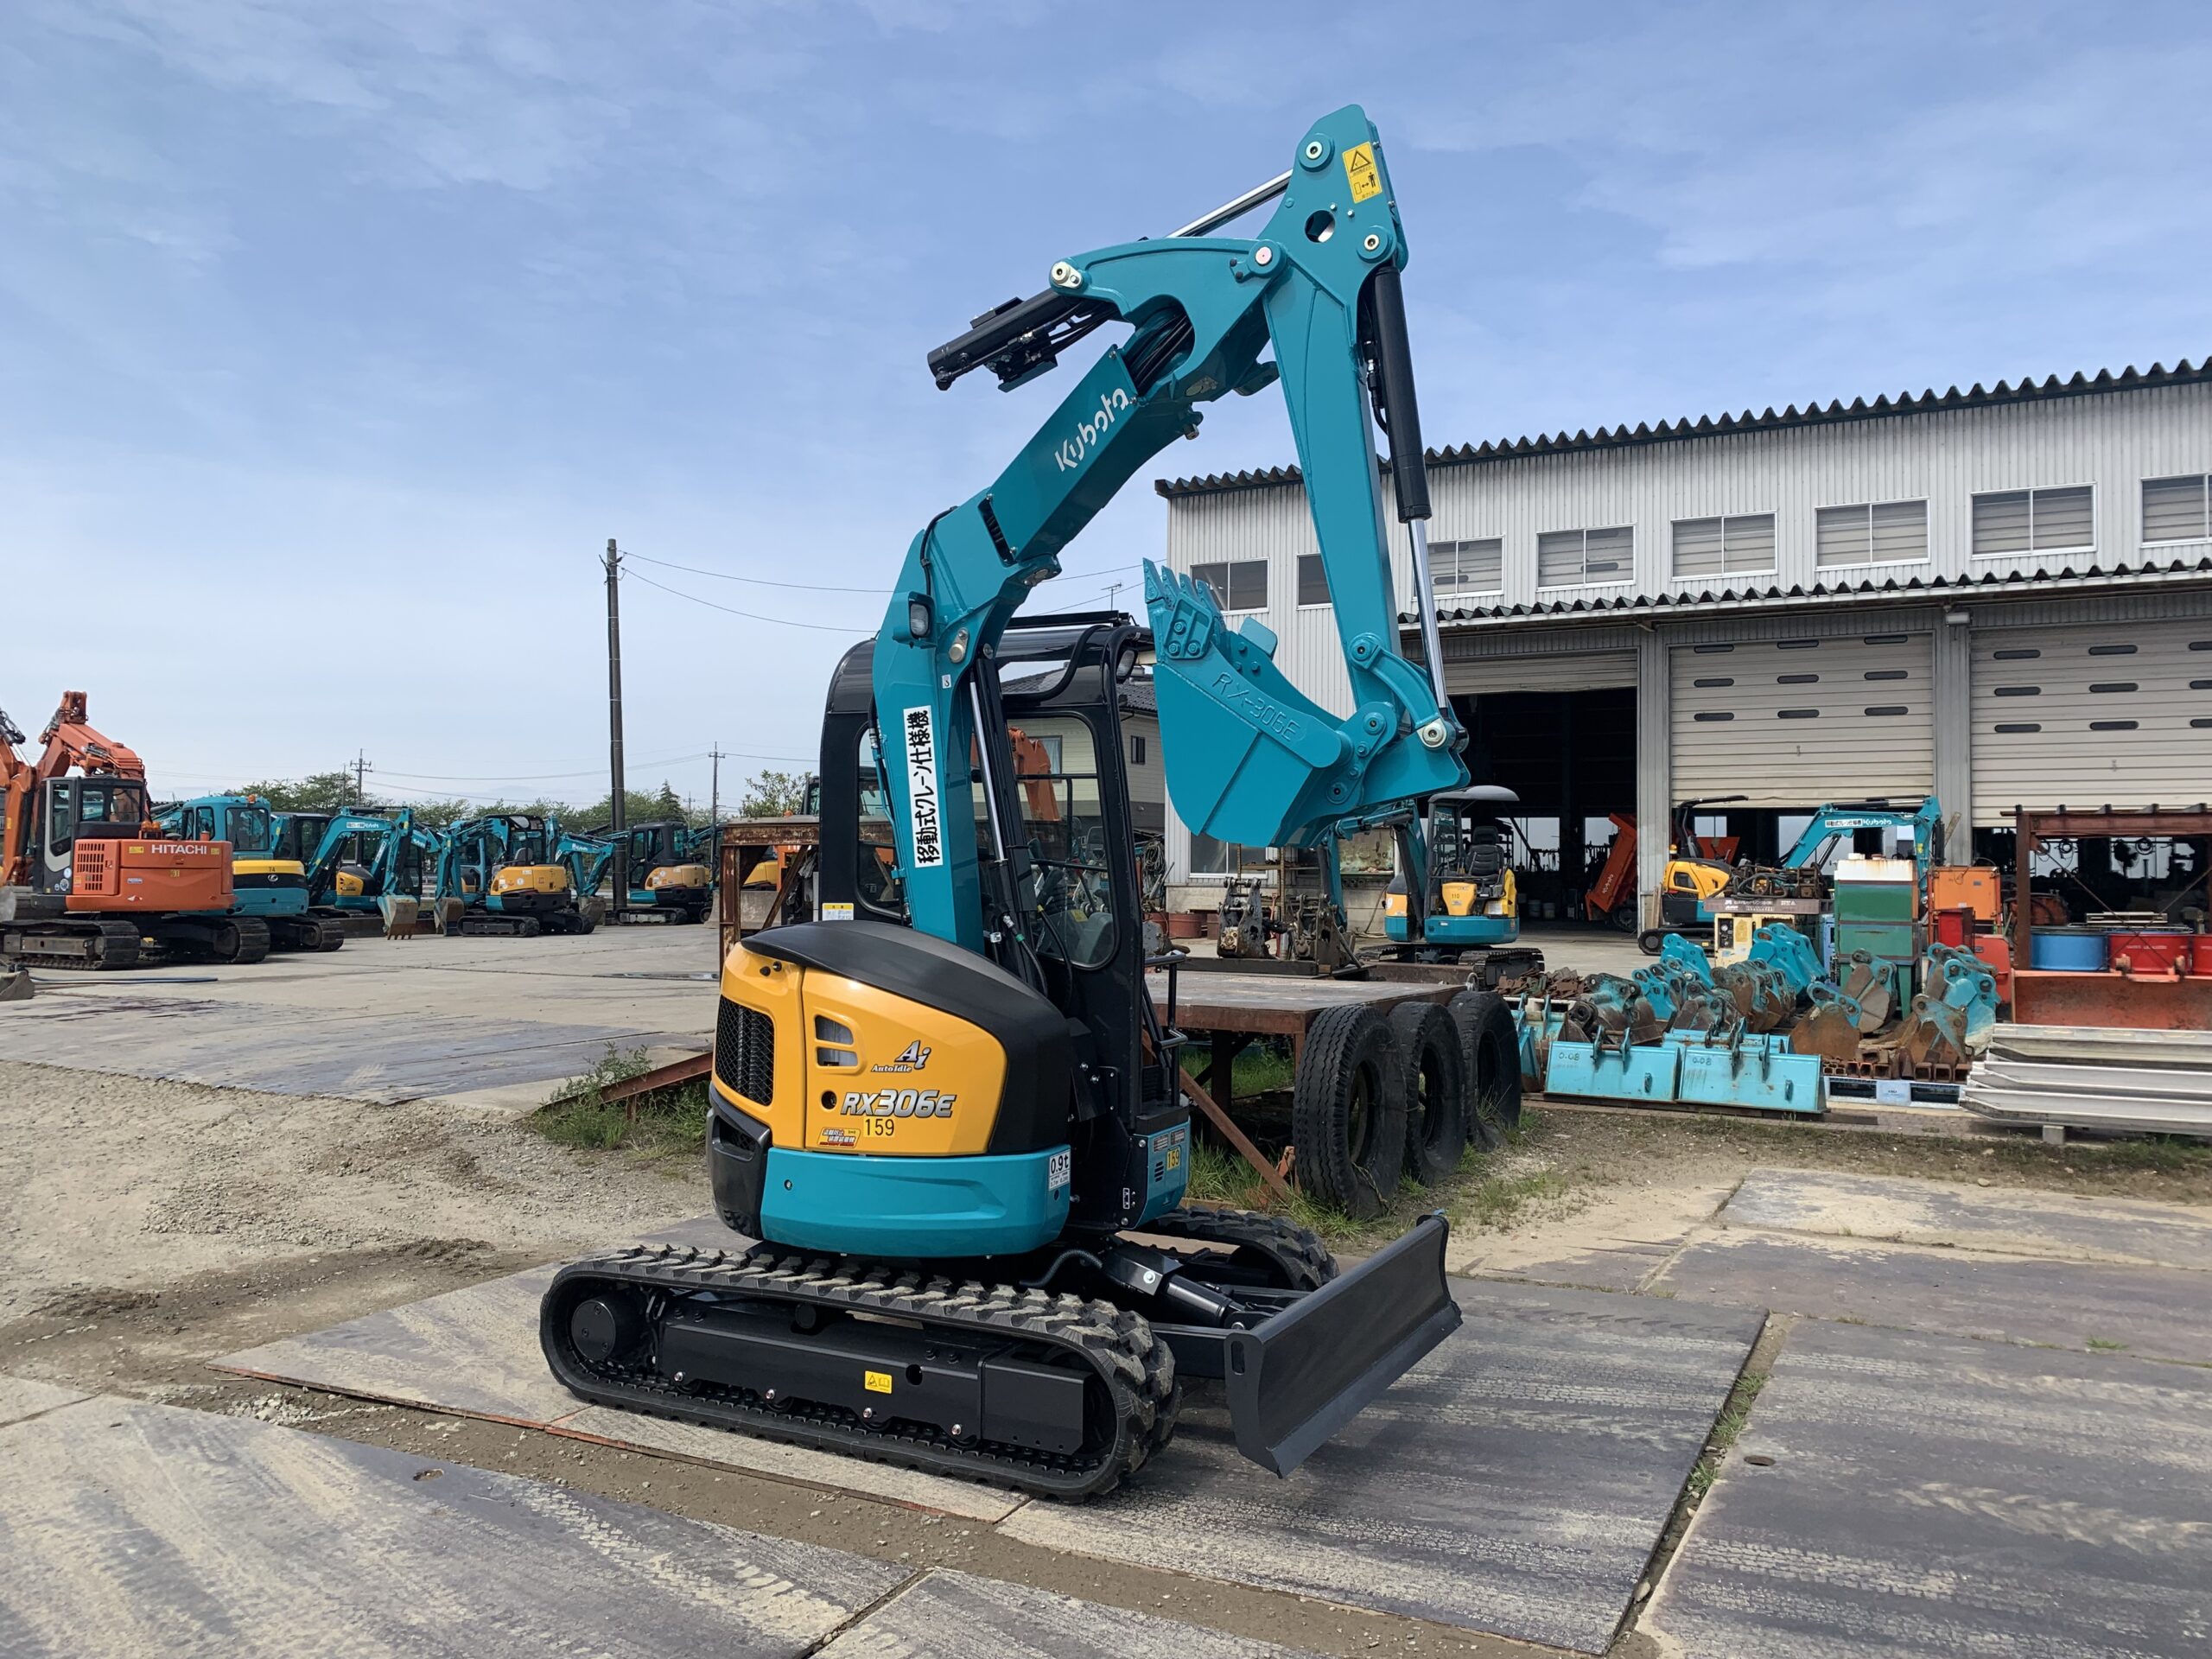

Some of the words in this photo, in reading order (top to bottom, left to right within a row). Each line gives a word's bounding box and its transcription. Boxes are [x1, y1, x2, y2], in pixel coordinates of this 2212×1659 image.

[1054, 388, 1129, 473] Kubota
[1212, 672, 1301, 741] RX-306E
[906, 709, 941, 864] 移動式クレーン仕様機
[151, 844, 207, 855] HITACHI
[871, 1064, 912, 1072] AutoIdle
[841, 1089, 957, 1118] RX306E
[865, 1118, 894, 1136] 159
[1051, 1154, 1069, 1173] 0.9t
[1168, 1149, 1179, 1168] 159
